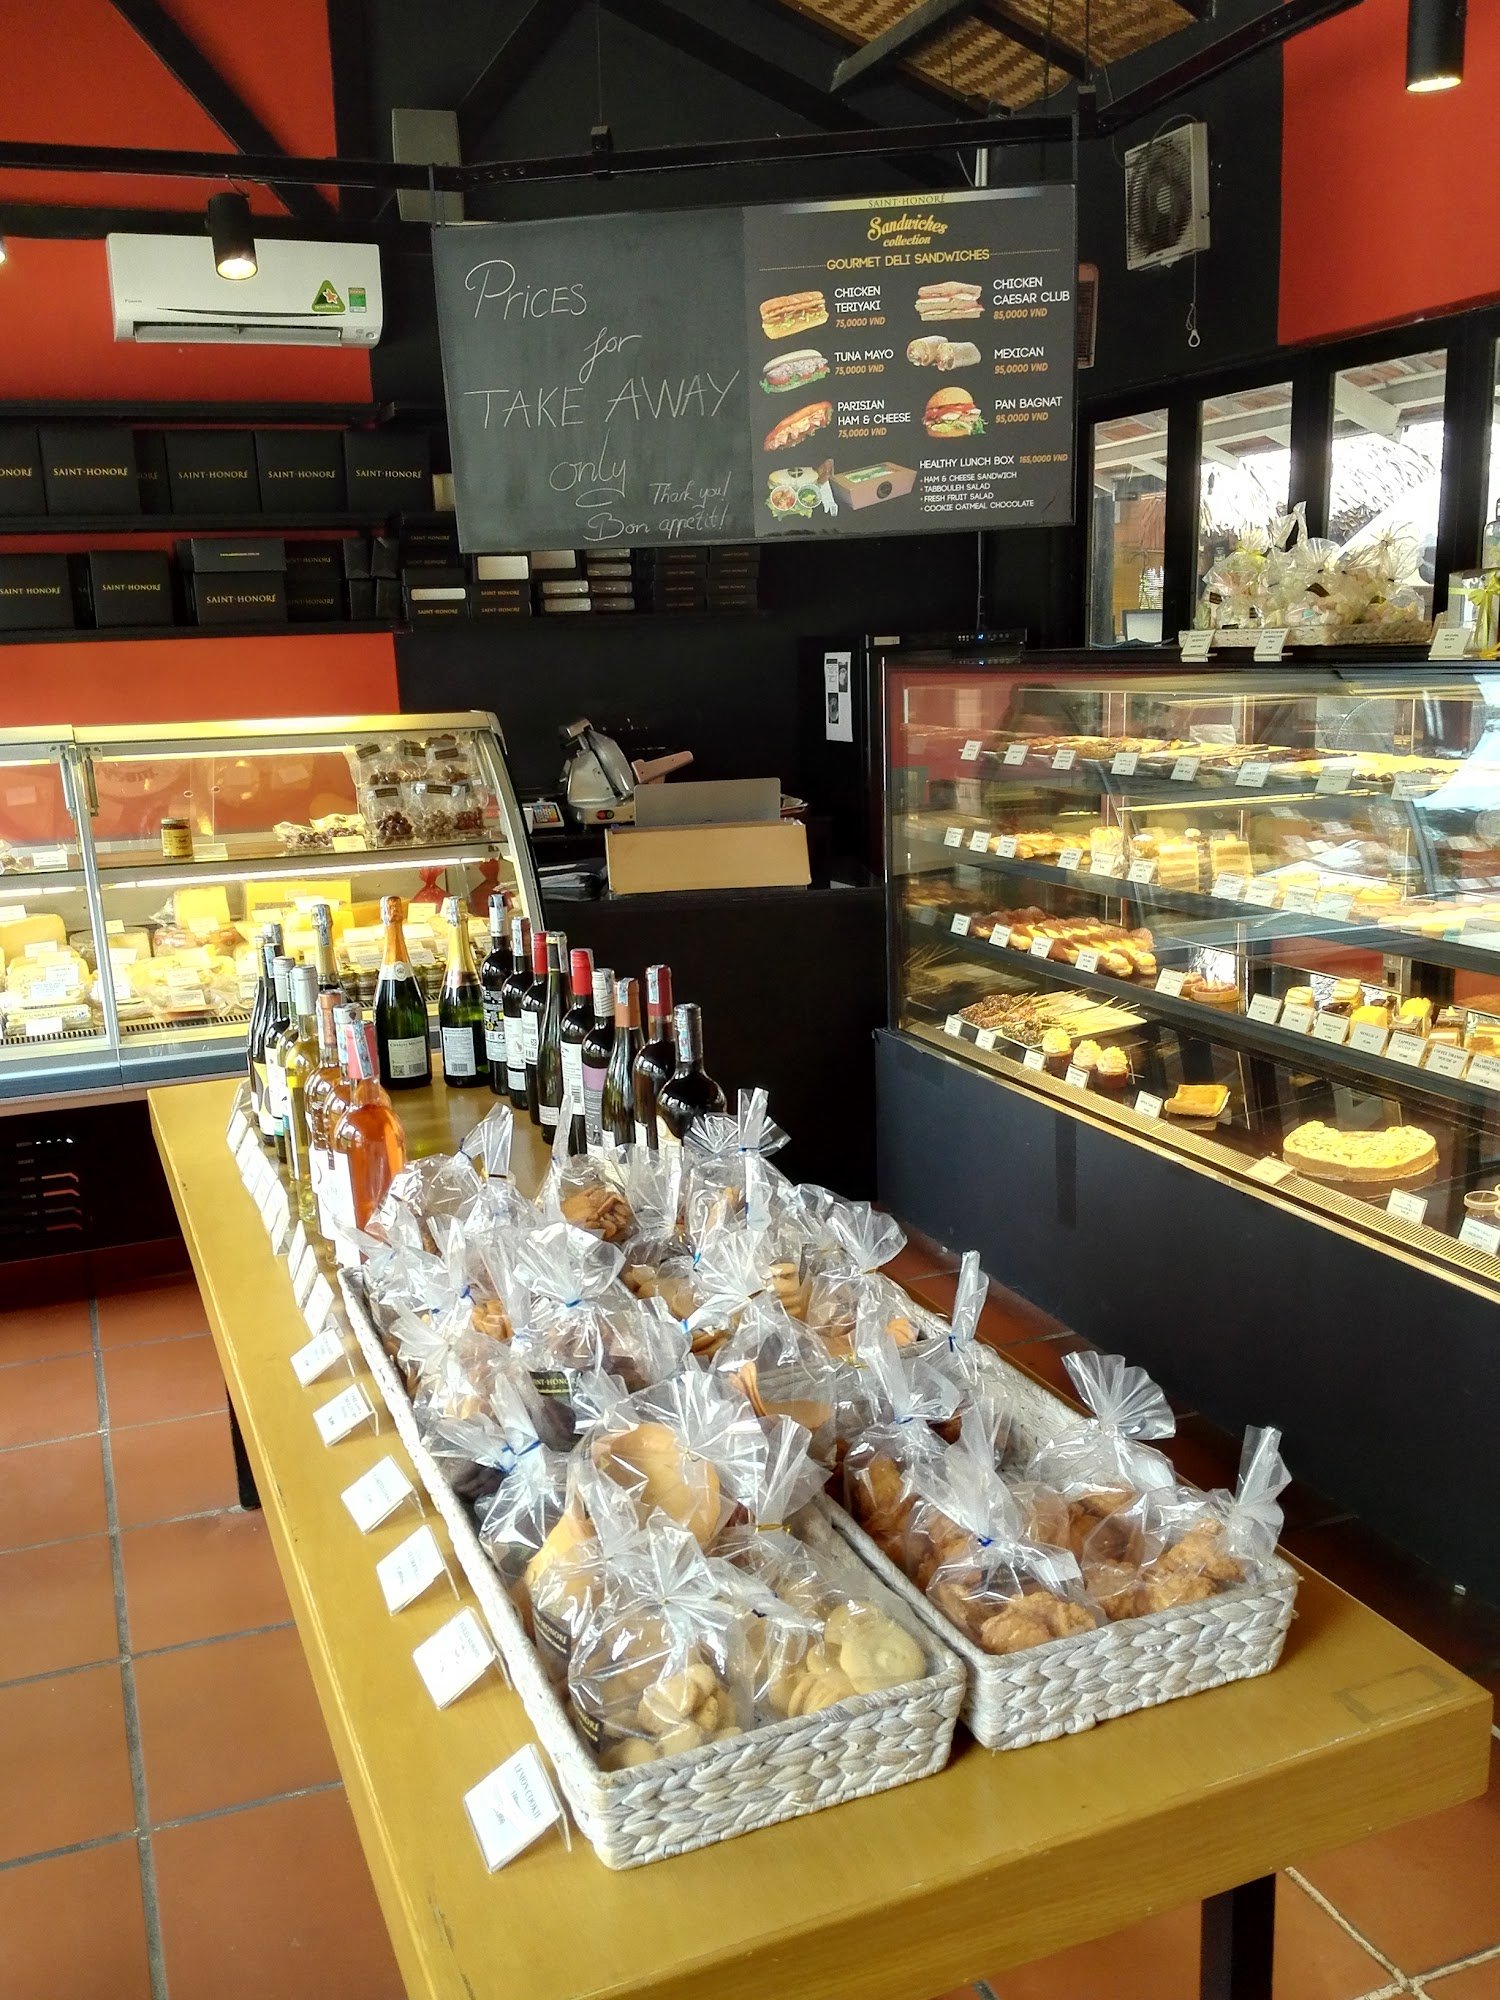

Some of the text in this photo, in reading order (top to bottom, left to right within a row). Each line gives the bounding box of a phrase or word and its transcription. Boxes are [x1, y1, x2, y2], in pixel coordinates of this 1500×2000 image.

[867, 213, 948, 241] Sandwiches
[883, 234, 931, 247] collection
[826, 249, 990, 271] GOURMET DELI SANDWICHES
[993, 276, 1043, 290] CHICKEN
[835, 285, 881, 299] CHICKEN
[993, 290, 1071, 307] CAESAR CLUB
[835, 300, 881, 314] TERIYAKI
[1029, 307, 1048, 319] VND
[835, 316, 886, 329] 75,0000 VND
[579, 326, 642, 384] for
[835, 349, 894, 363] TUNA MAYO
[994, 347, 1044, 360] MEXICAN
[835, 363, 885, 376] 75,0000 VND
[994, 362, 1048, 375] 95,0000 VND
[463, 369, 740, 429] TAKE AWAY
[838, 400, 885, 412] PARISIAN
[995, 396, 1063, 410] PAN BAGNAT
[838, 411, 911, 426] HAM & CHEESE
[995, 412, 1049, 424] 95,0000 VND
[838, 427, 887, 438] 75,0000 VND
[549, 428, 626, 508] only
[919, 458, 958, 469] HEALTHY
[960, 457, 991, 467] LUNCH
[994, 455, 1015, 466] BOX
[1052, 453, 1068, 462] VND
[924, 471, 1017, 484] HAM & CHEESE SANDWICH
[649, 471, 732, 509] Thank you!
[924, 482, 991, 493] TABBOULEH SALAD
[924, 492, 994, 503] FRESH FRUIT SALAD
[924, 499, 1034, 512] COOKIE OATMEAL CHOCOLATE
[583, 512, 650, 542] Bon
